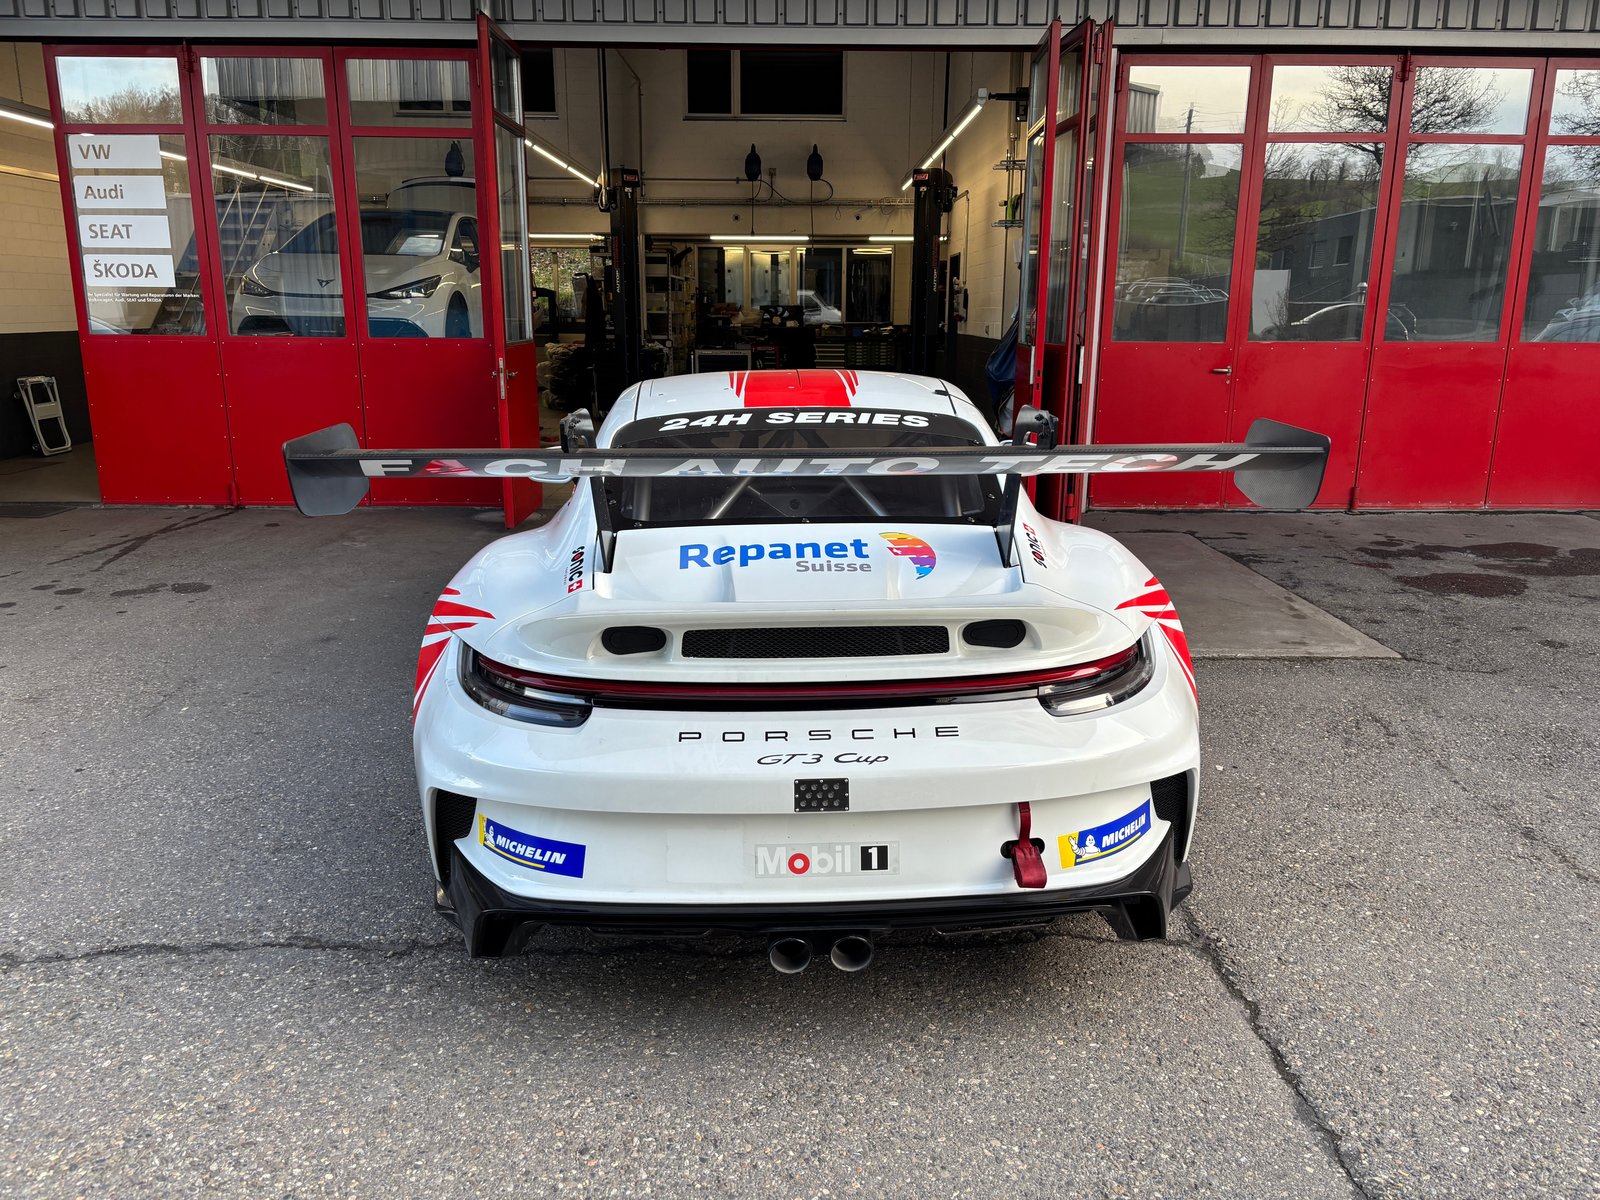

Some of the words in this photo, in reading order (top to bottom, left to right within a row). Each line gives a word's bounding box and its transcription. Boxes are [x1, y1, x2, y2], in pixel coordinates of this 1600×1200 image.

[78, 144, 111, 159] VW
[84, 184, 124, 199] Audi
[88, 224, 133, 239] SEAT
[93, 259, 158, 279] ŠKODA
[658, 413, 753, 432] 24H
[765, 412, 930, 428] SERIES
[359, 458, 627, 477] FACH
[658, 457, 940, 477] AUTO
[982, 453, 1261, 473] TECH
[679, 538, 870, 570] Repanet
[795, 560, 872, 573] Suisse
[678, 726, 960, 742] PORSCHE
[833, 752, 889, 766] Cup
[1101, 812, 1146, 848] MICHELIN
[496, 834, 567, 865] MICHELIN
[757, 844, 851, 876] Mobil
